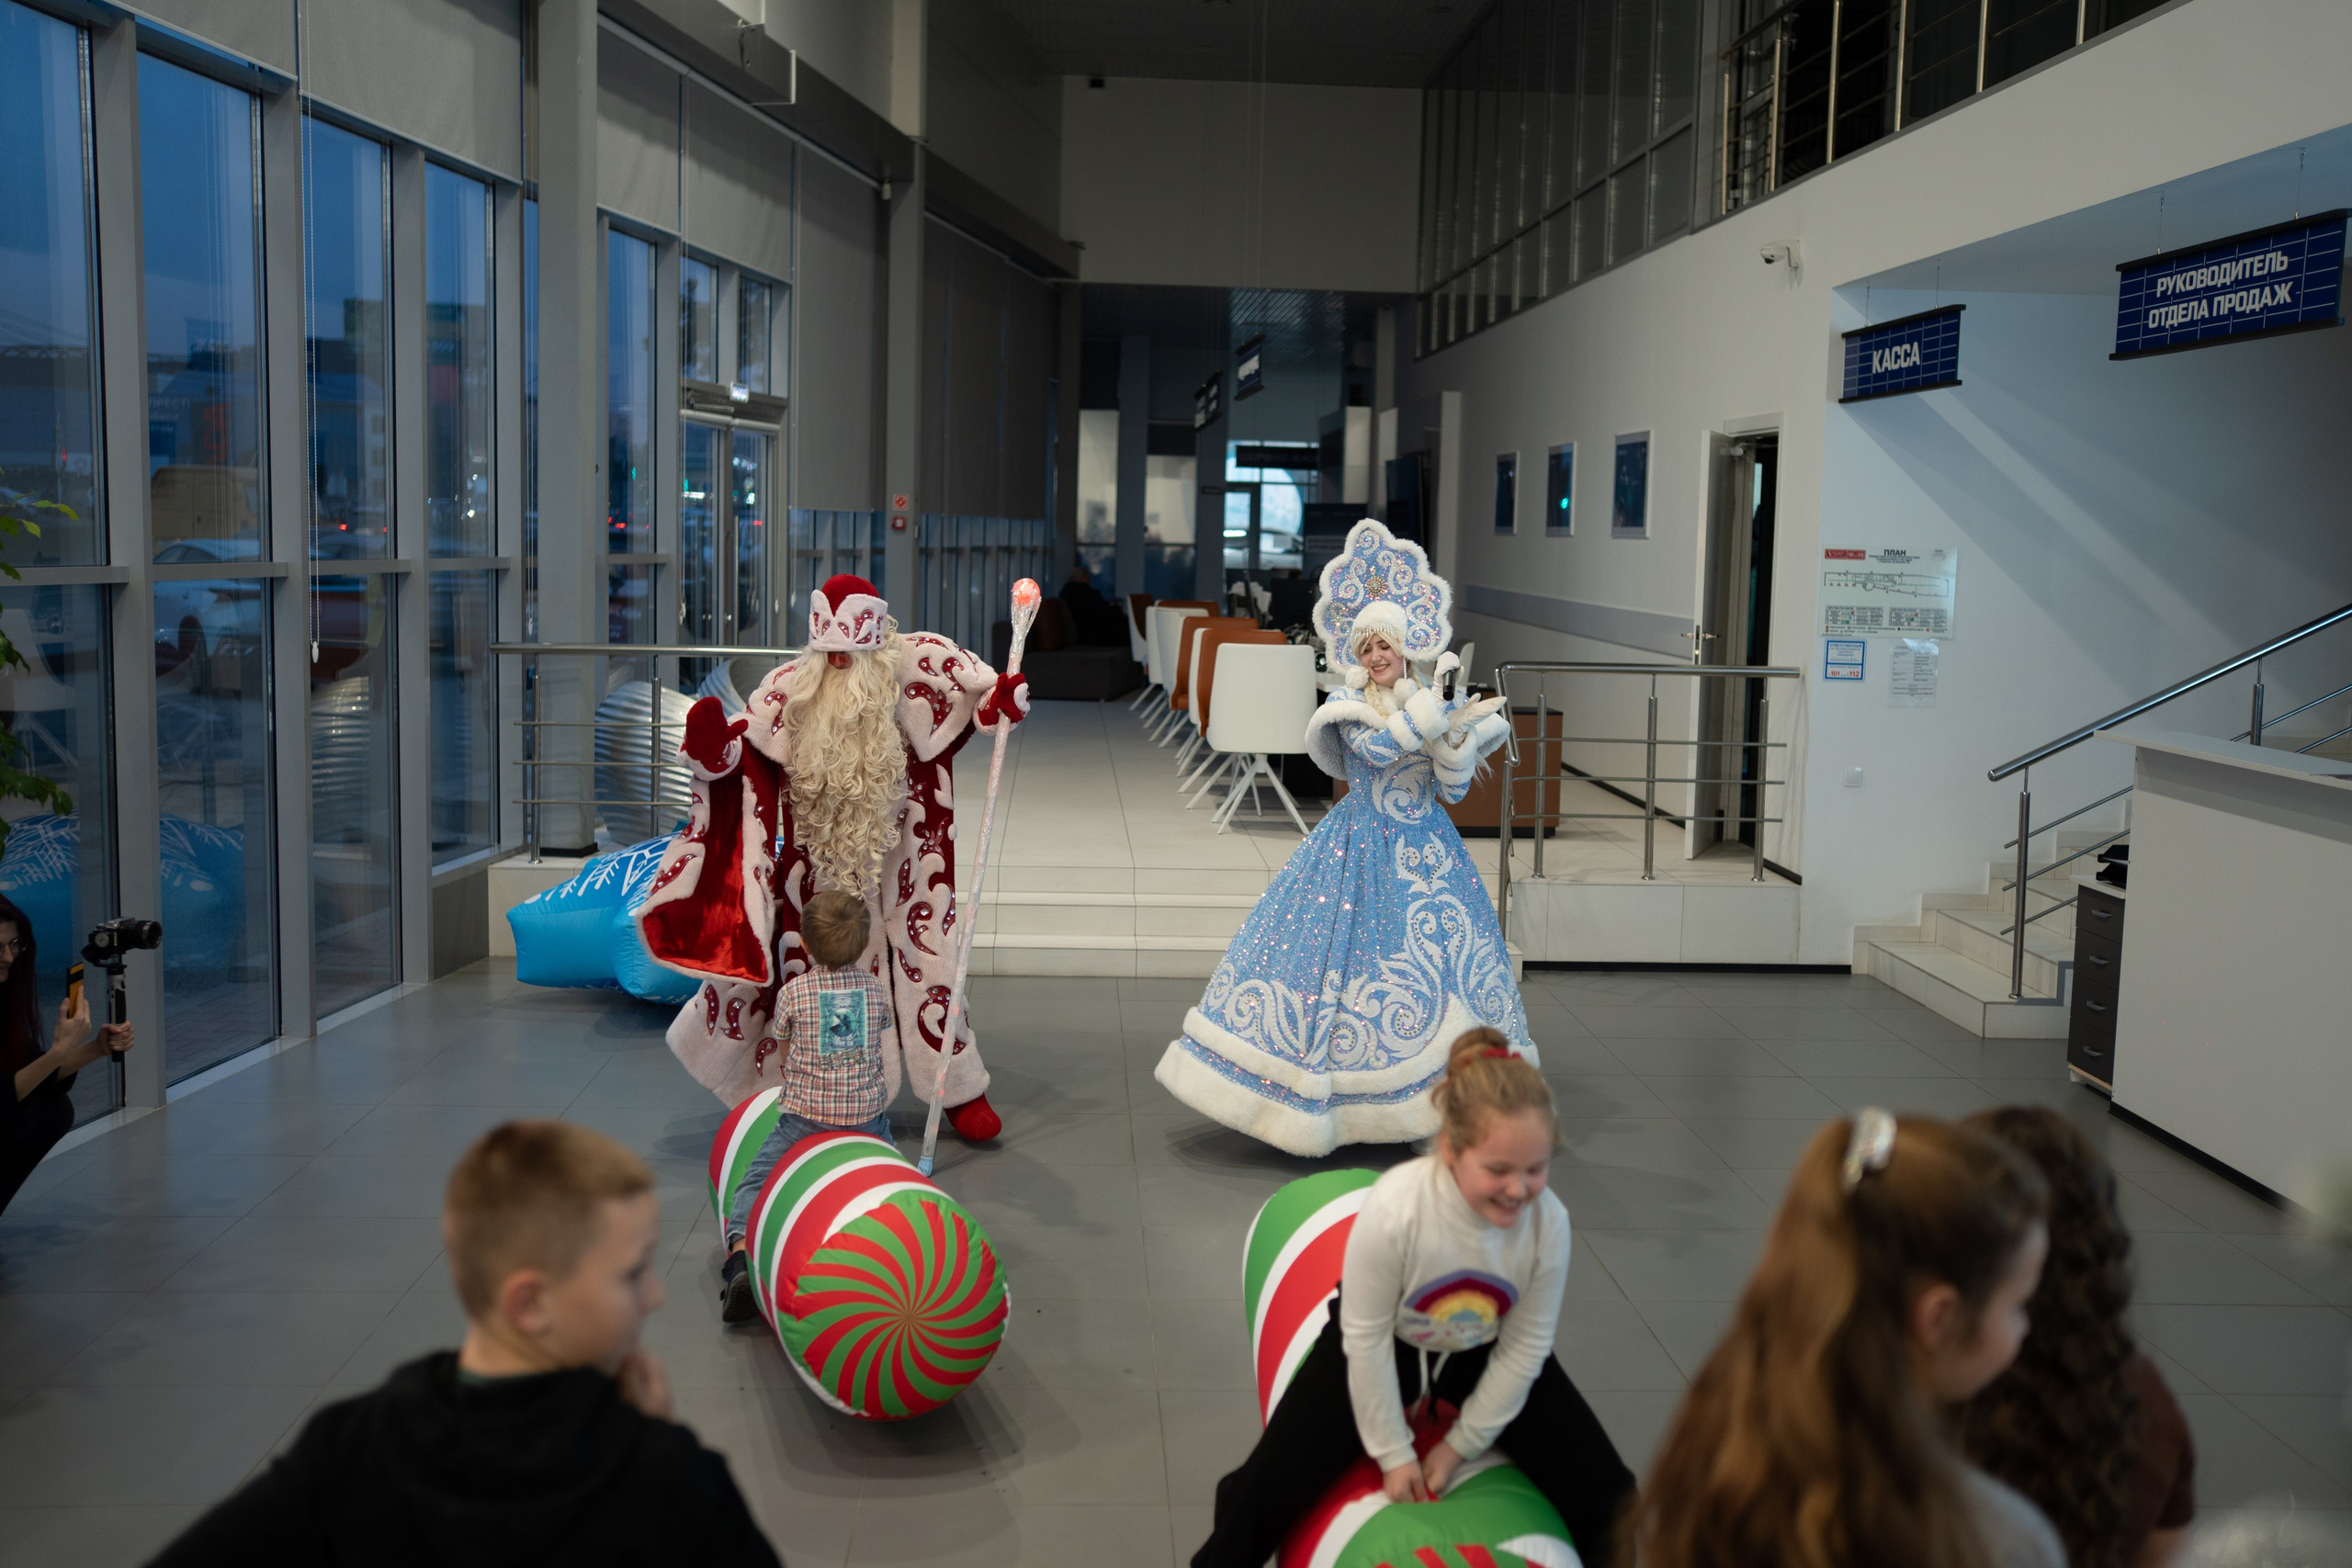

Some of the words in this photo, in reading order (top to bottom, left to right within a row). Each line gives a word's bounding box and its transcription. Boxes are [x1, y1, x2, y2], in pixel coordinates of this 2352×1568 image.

[2156, 251, 2289, 298] РУКОВОДИТЕЛЬ
[2148, 299, 2209, 329] ОТДЕЛА
[2212, 281, 2294, 317] ПРОДАЖ
[1871, 341, 1920, 374] КАССА
